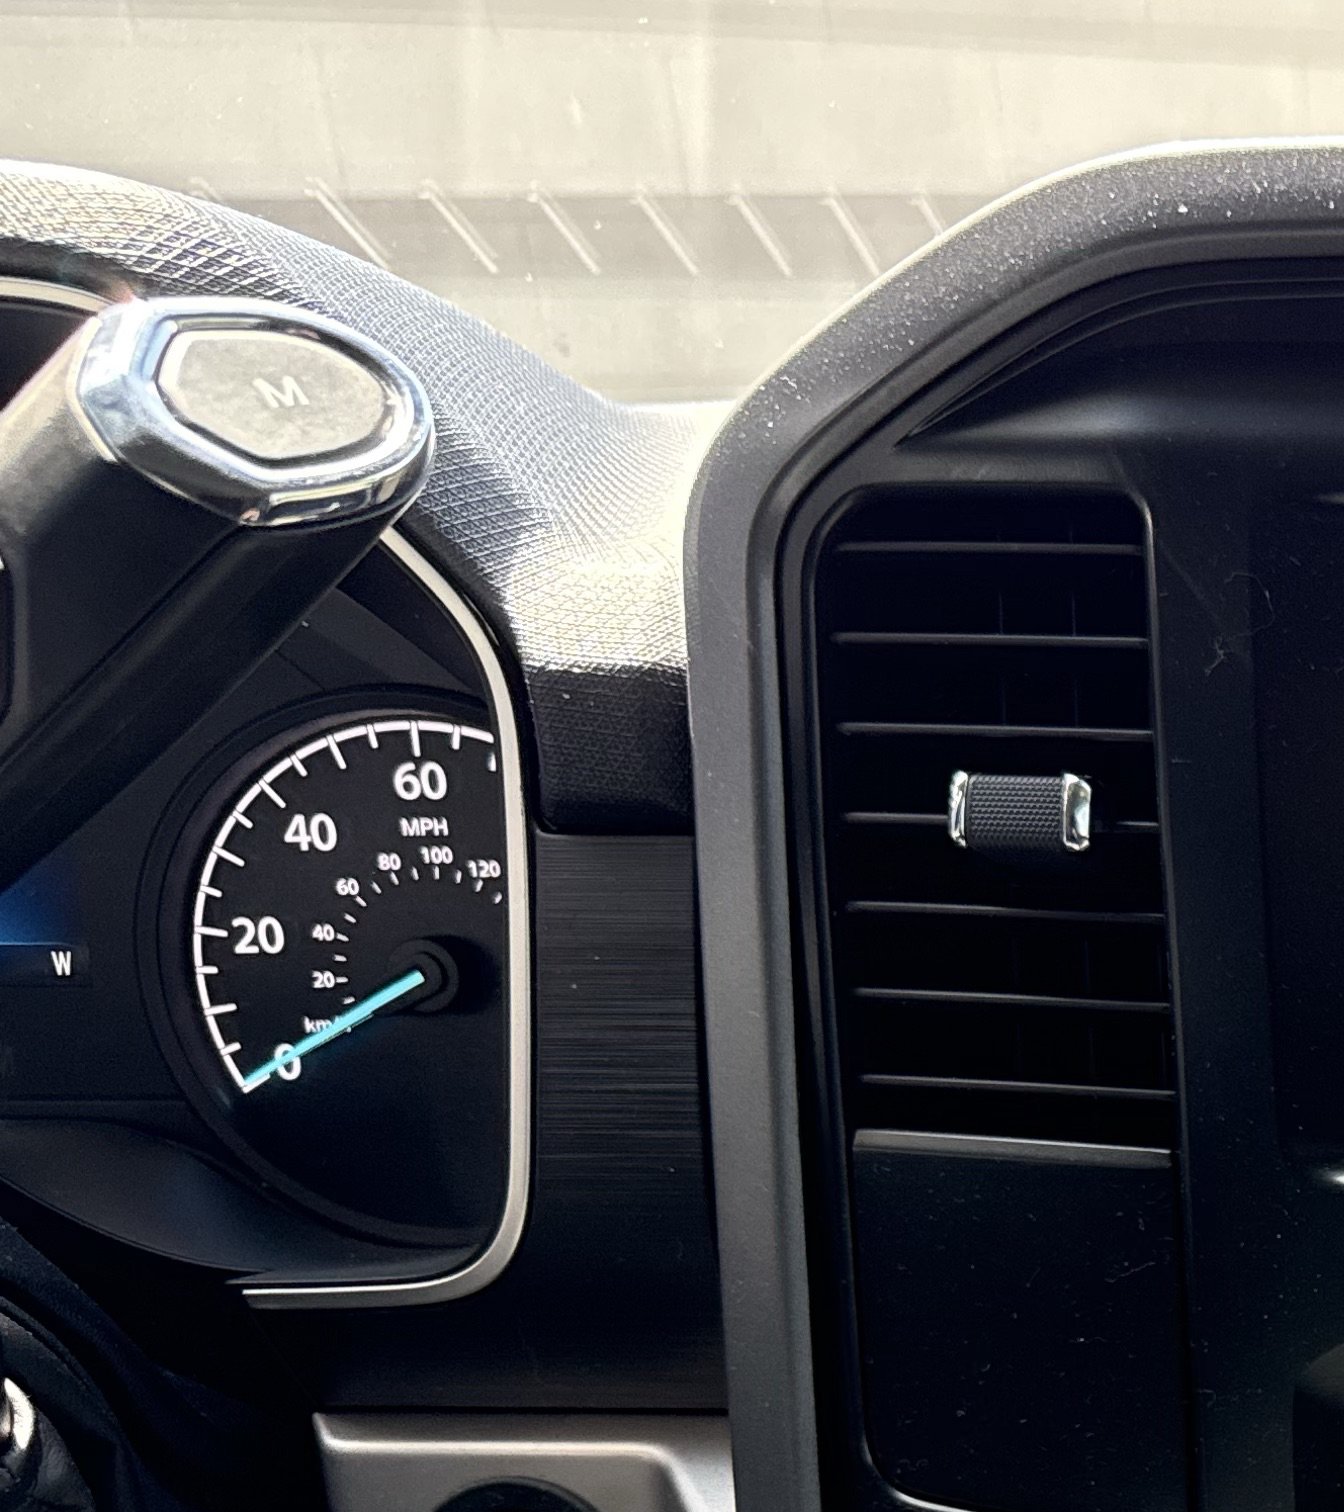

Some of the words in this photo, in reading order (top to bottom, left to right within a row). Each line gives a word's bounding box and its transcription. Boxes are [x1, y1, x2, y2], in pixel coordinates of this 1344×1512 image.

[250, 375, 310, 411] M
[393, 760, 448, 801] 60
[283, 812, 338, 852] 40
[399, 816, 449, 837] MPH
[377, 851, 402, 870] 80
[420, 846, 454, 865] 100
[466, 859, 502, 878] 120
[335, 877, 360, 896] 60
[231, 915, 286, 955] 20
[311, 923, 336, 942] 40
[50, 950, 72, 977] W
[311, 970, 336, 988] 20
[273, 1043, 302, 1081] 0
